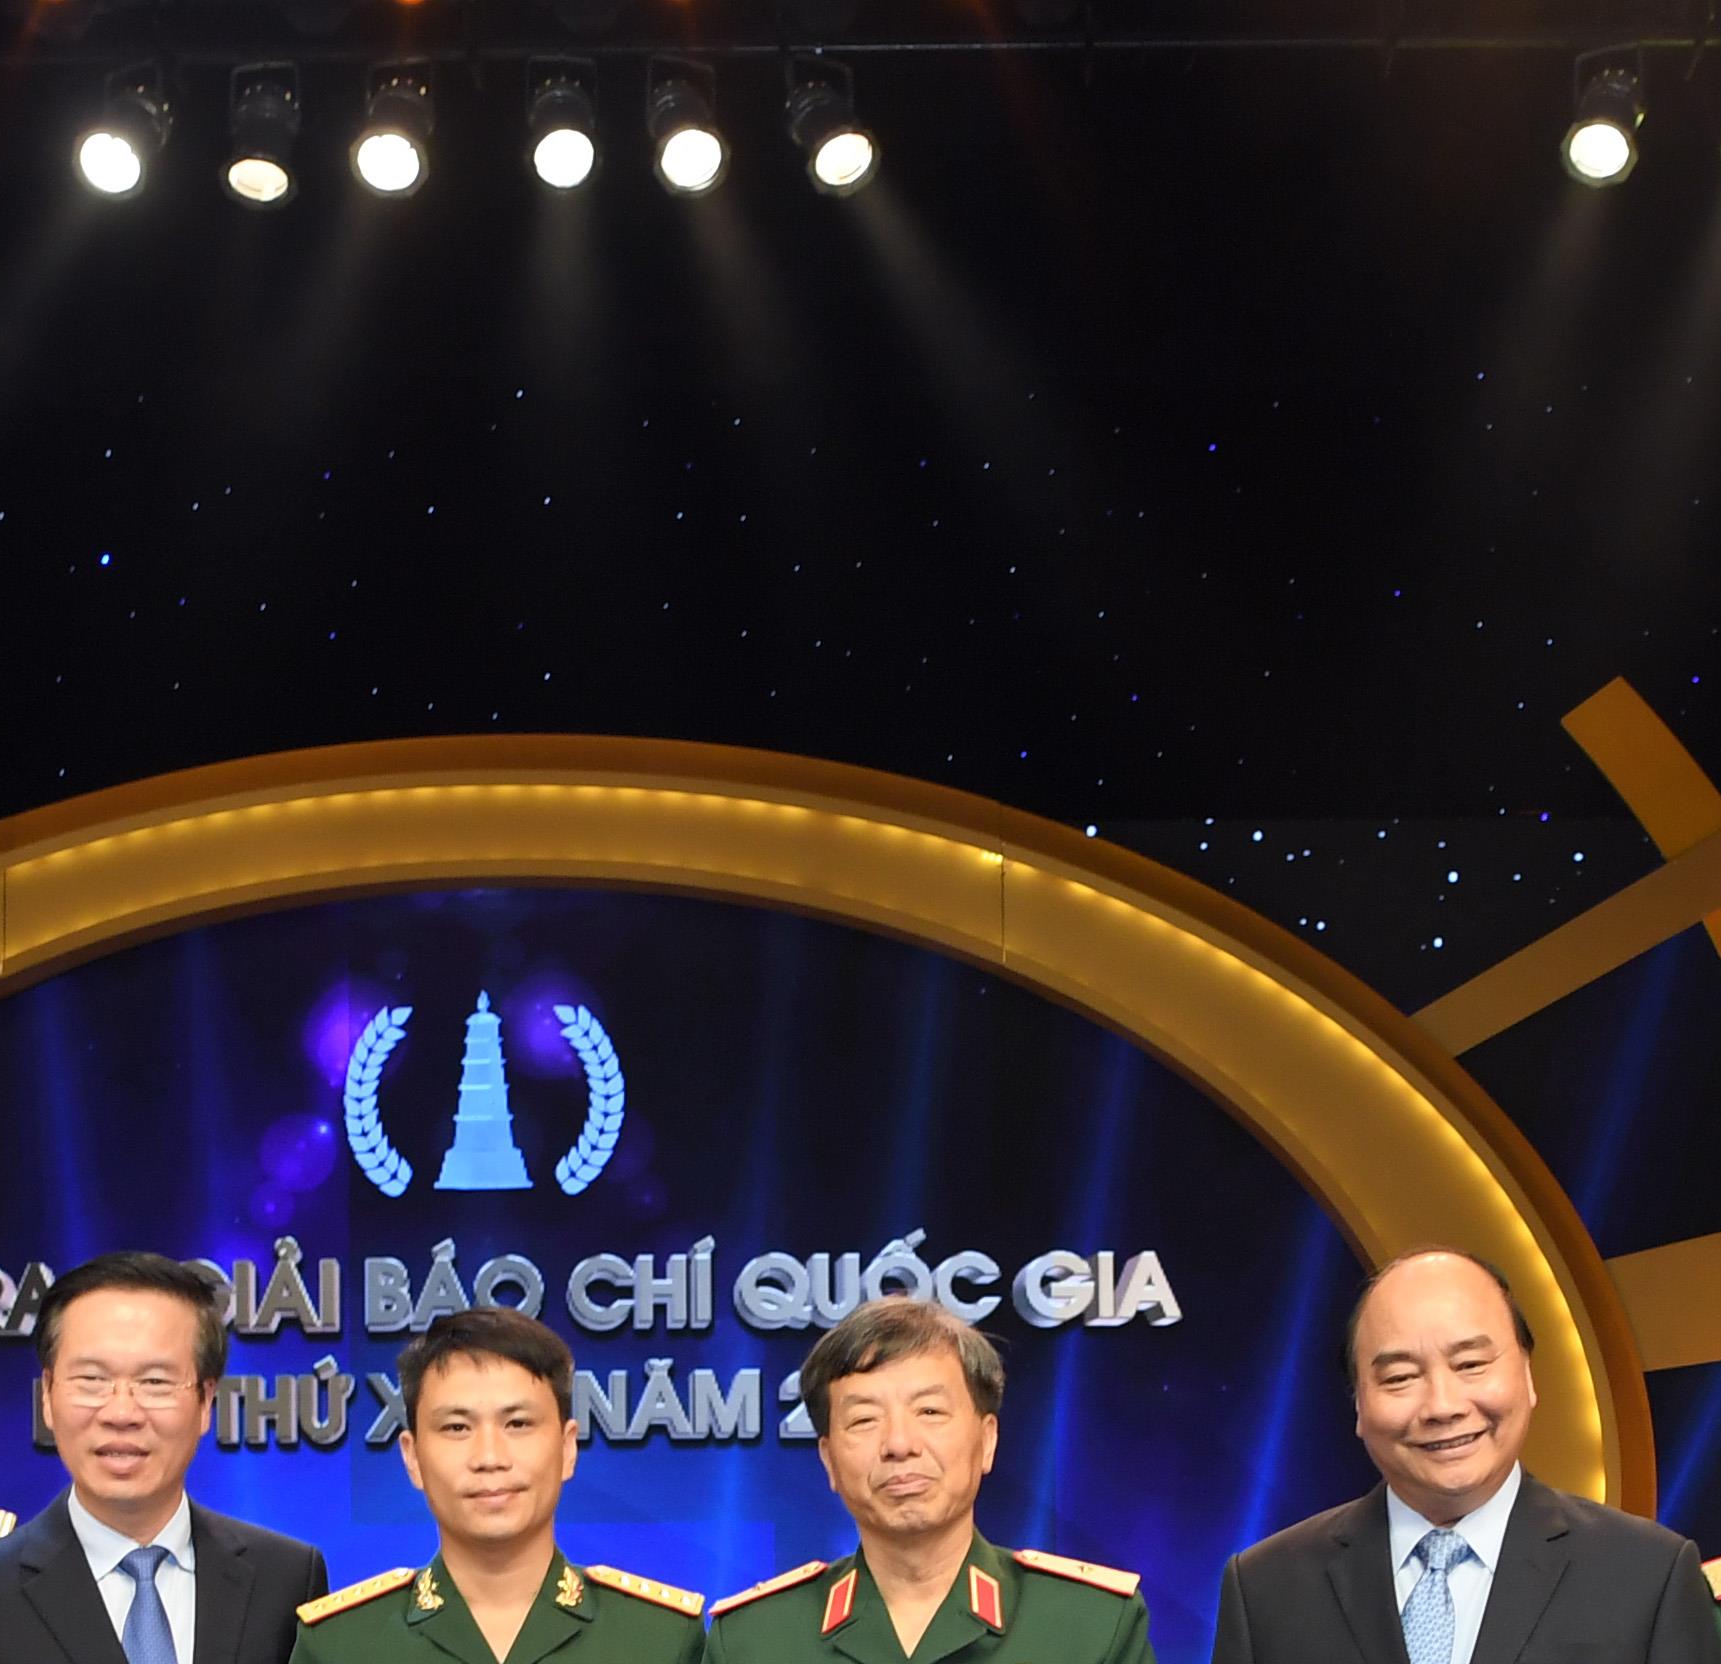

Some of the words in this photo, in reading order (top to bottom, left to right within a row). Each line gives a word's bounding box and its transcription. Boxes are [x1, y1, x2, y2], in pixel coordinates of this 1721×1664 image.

[364, 1237, 545, 1333] BÁO
[568, 1234, 716, 1331] CHÍ
[733, 1227, 1002, 1328] QUỐC
[1012, 1250, 1183, 1328] GIA
[215, 1354, 355, 1444] THỨ
[572, 1358, 761, 1441] NĂM
